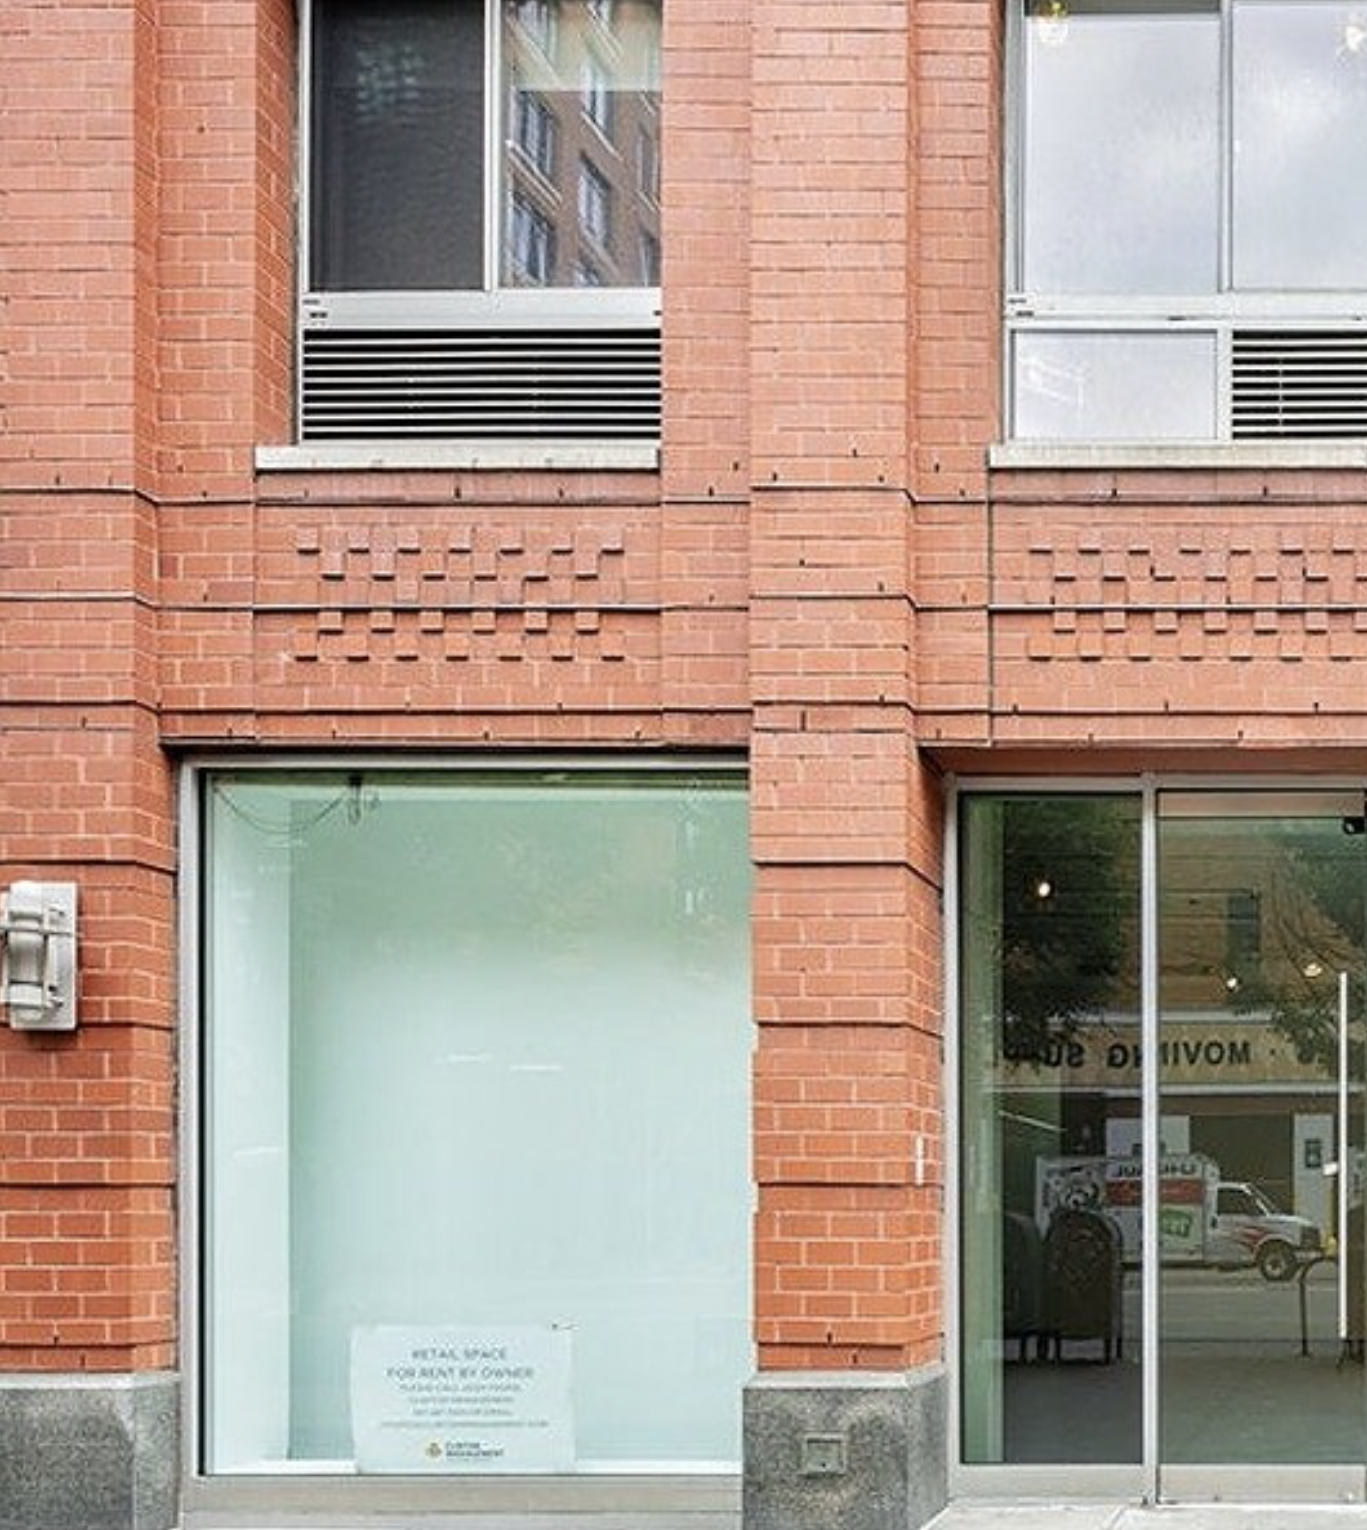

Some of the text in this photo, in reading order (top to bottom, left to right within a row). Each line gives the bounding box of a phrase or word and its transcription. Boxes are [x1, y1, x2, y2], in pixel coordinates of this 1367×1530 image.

[411, 1349, 507, 1360] RETAIL SPACE
[386, 1367, 534, 1379] FOR RENT BY OWNER
